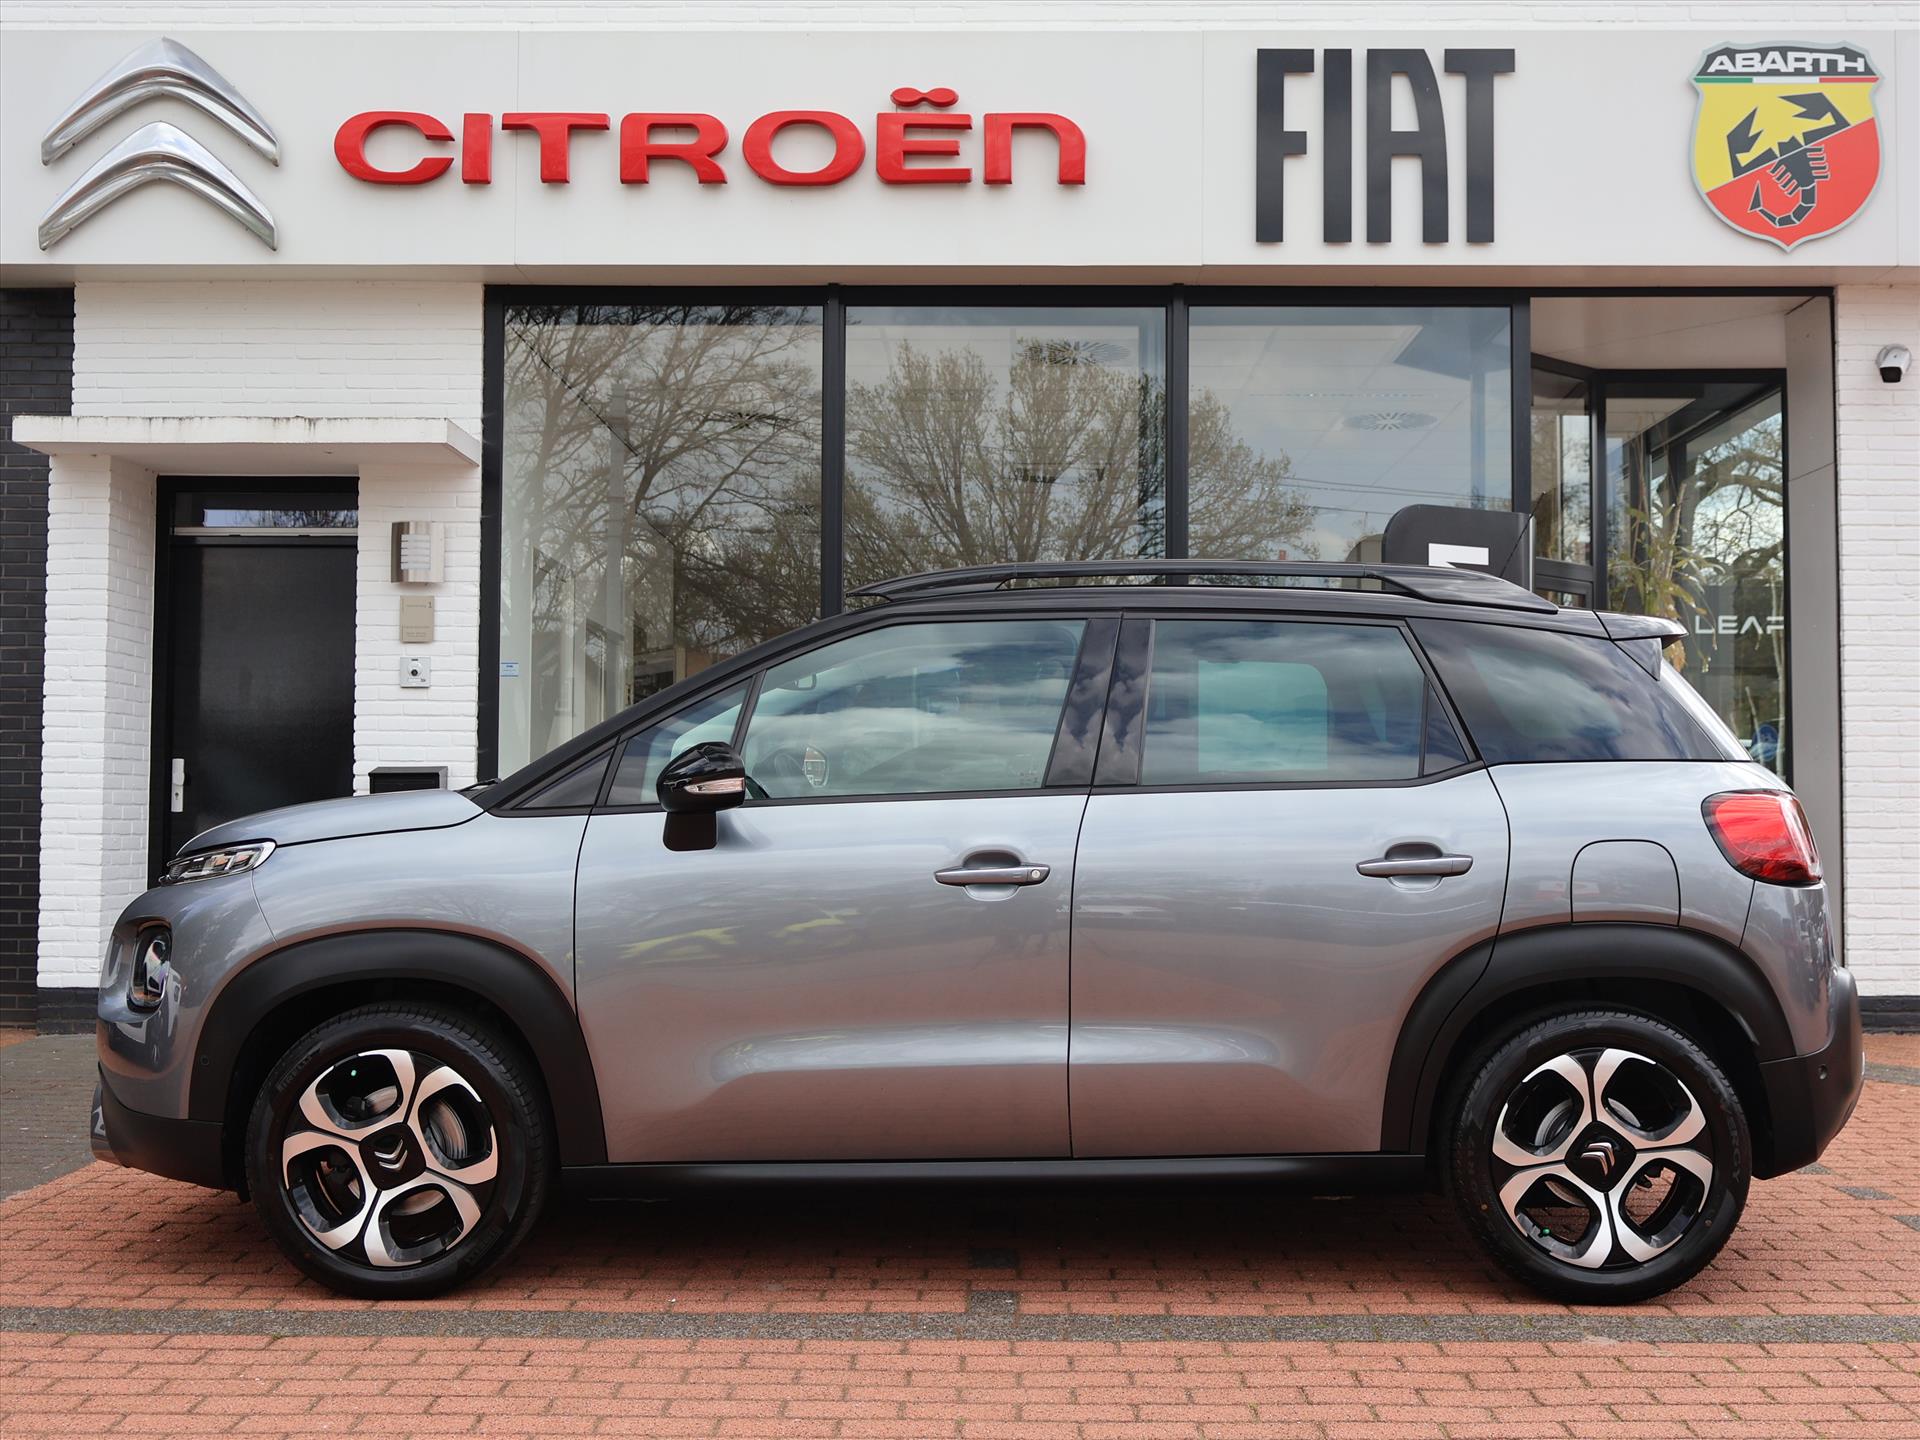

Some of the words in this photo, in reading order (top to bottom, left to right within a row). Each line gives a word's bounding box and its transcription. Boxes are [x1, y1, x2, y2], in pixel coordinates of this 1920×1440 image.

[1706, 51, 1866, 73] ABARTH
[334, 87, 1086, 186] CITROËN
[1256, 48, 1515, 243] FIAT
